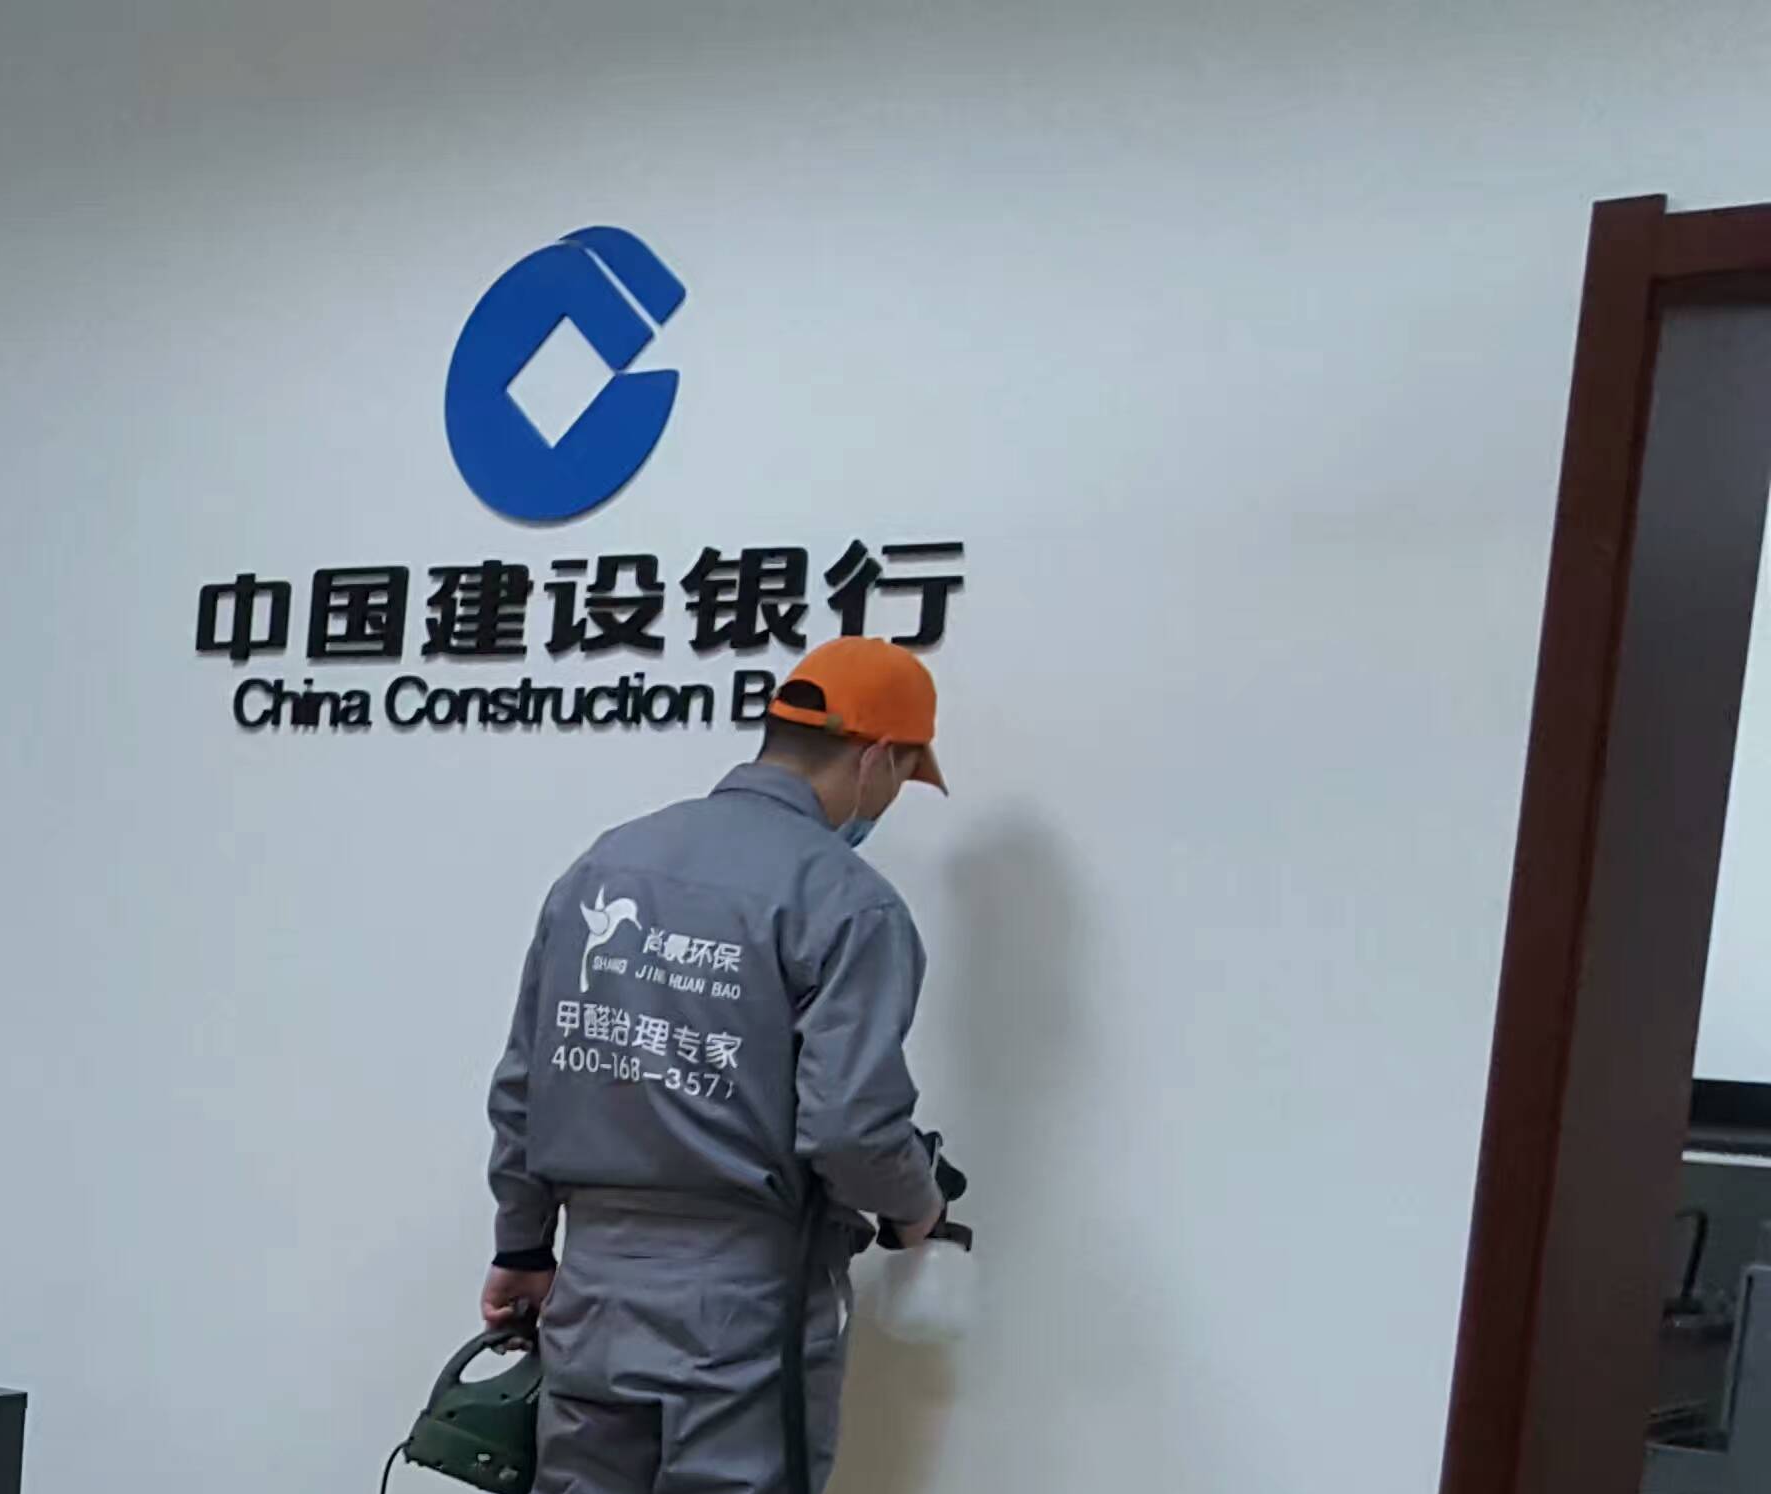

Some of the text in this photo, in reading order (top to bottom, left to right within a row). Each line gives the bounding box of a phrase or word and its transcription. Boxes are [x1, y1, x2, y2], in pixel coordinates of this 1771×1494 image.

[195, 540, 965, 661] 中国建设银行
[233, 677, 371, 730] China
[385, 672, 714, 729] Construction
[711, 981, 742, 1000] BAO
[556, 1000, 743, 1069] 甲醛治理专家
